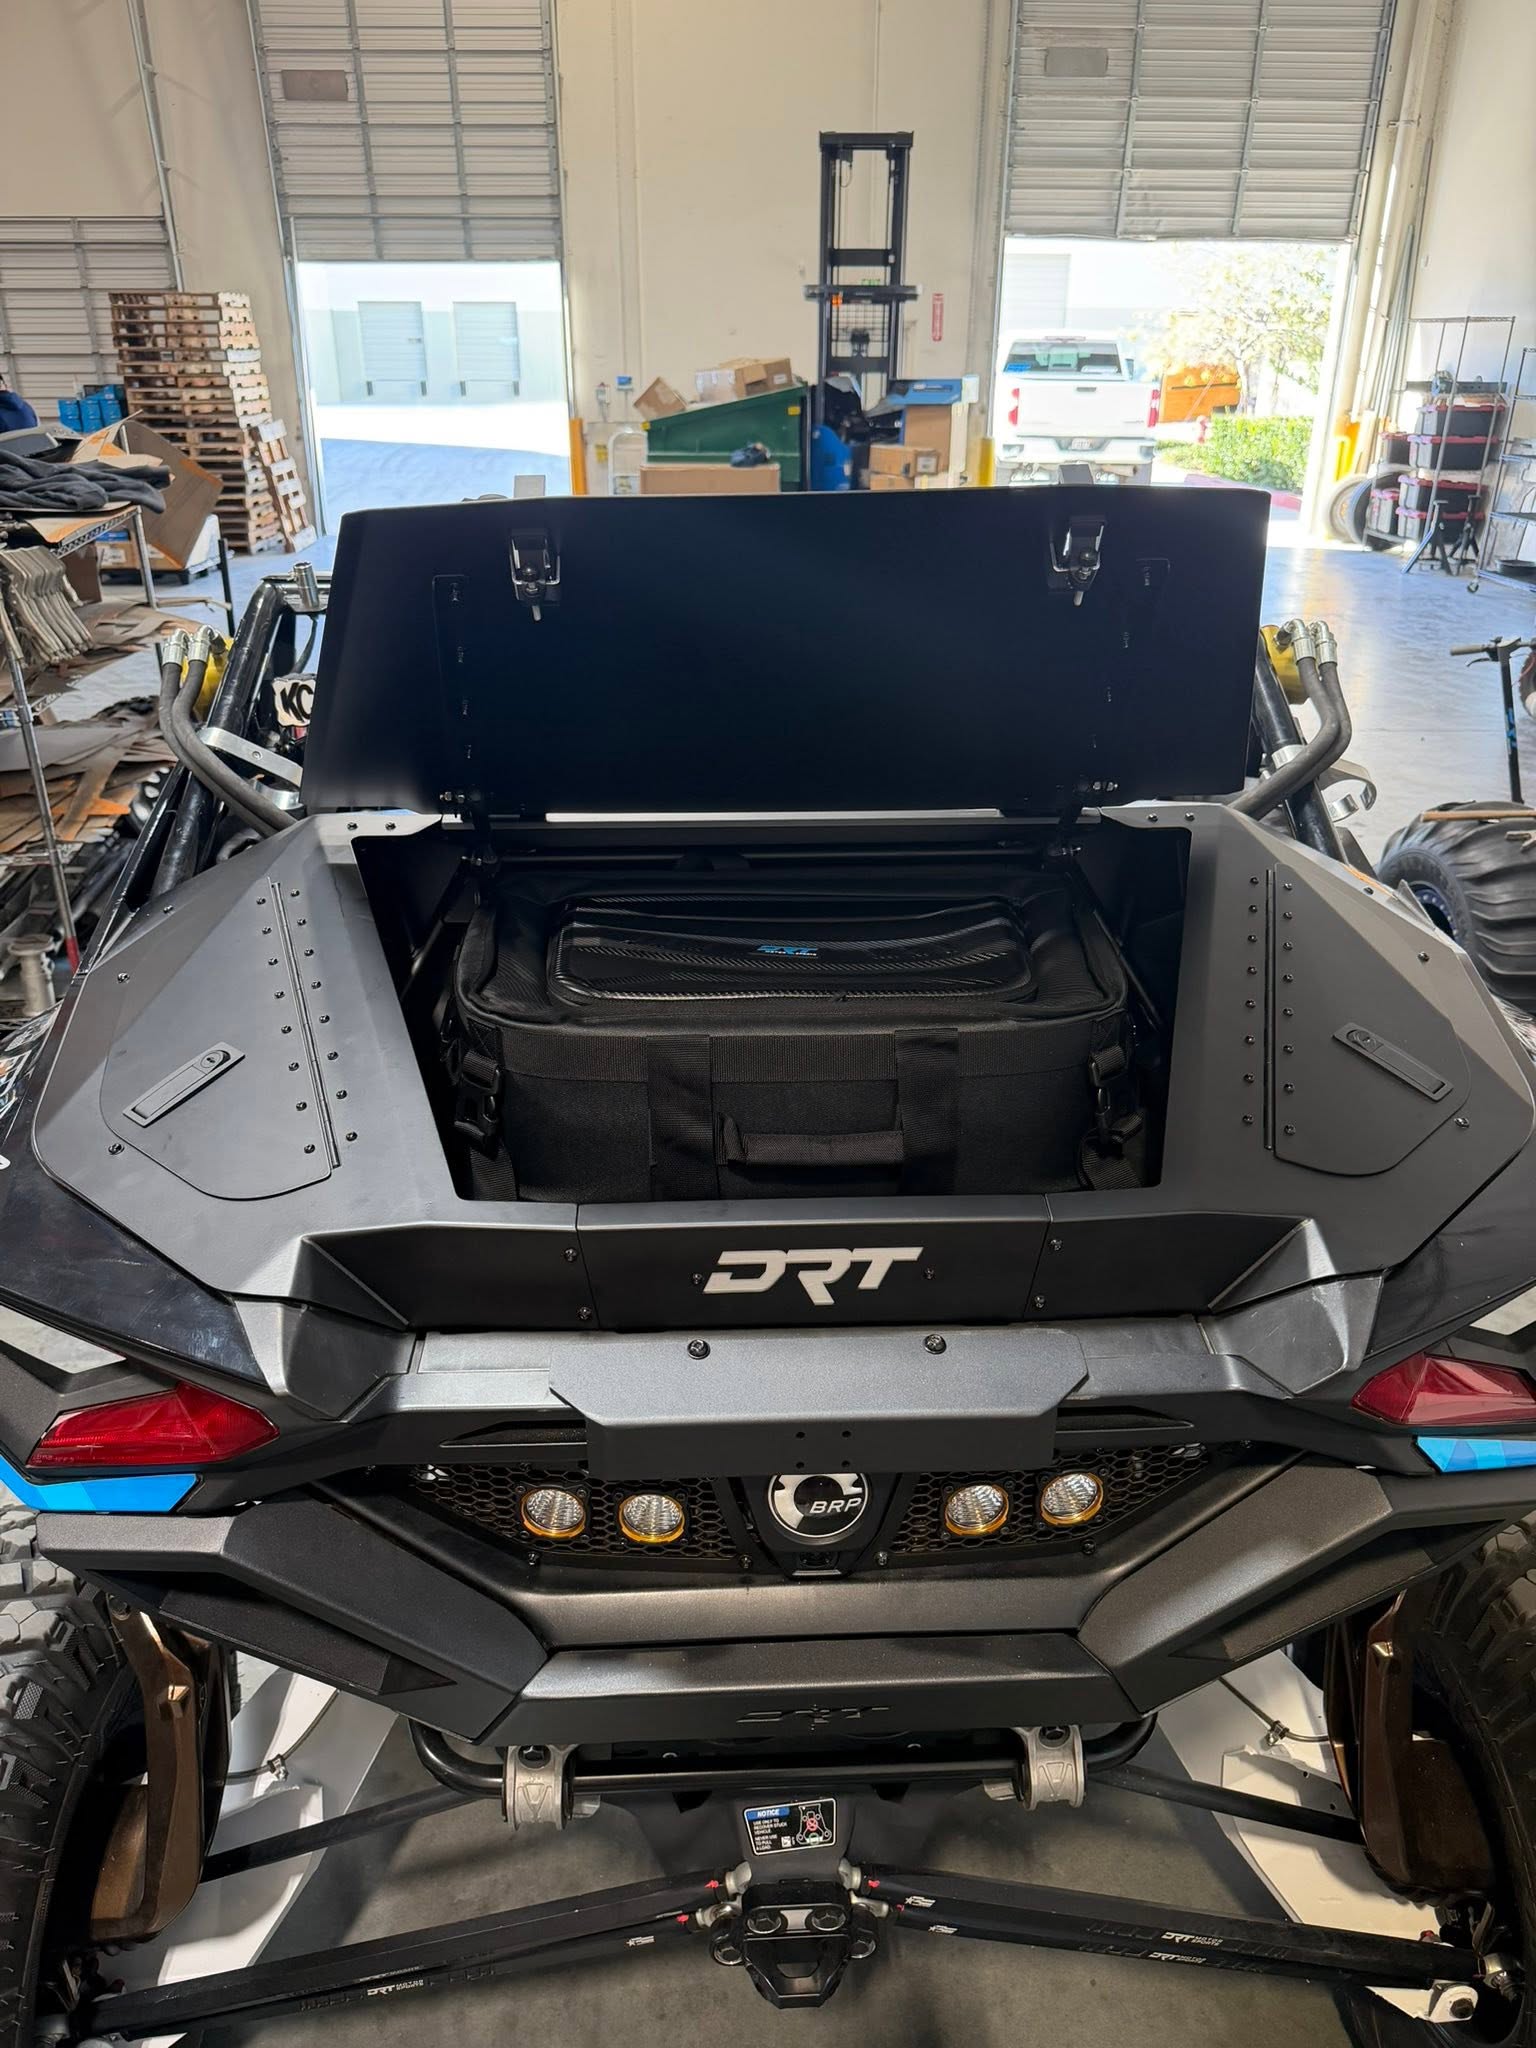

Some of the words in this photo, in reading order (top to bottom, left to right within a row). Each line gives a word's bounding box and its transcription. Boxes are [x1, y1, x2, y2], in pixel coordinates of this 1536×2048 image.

[280, 682, 314, 723] KC
[703, 1247, 923, 1306] DRT
[809, 1498, 862, 1514] BRP
[757, 1809, 780, 1817] NOTICE
[1161, 1931, 1195, 1943] DRT
[1148, 1952, 1180, 1961] DRT
[367, 1985, 395, 1996] DRT
